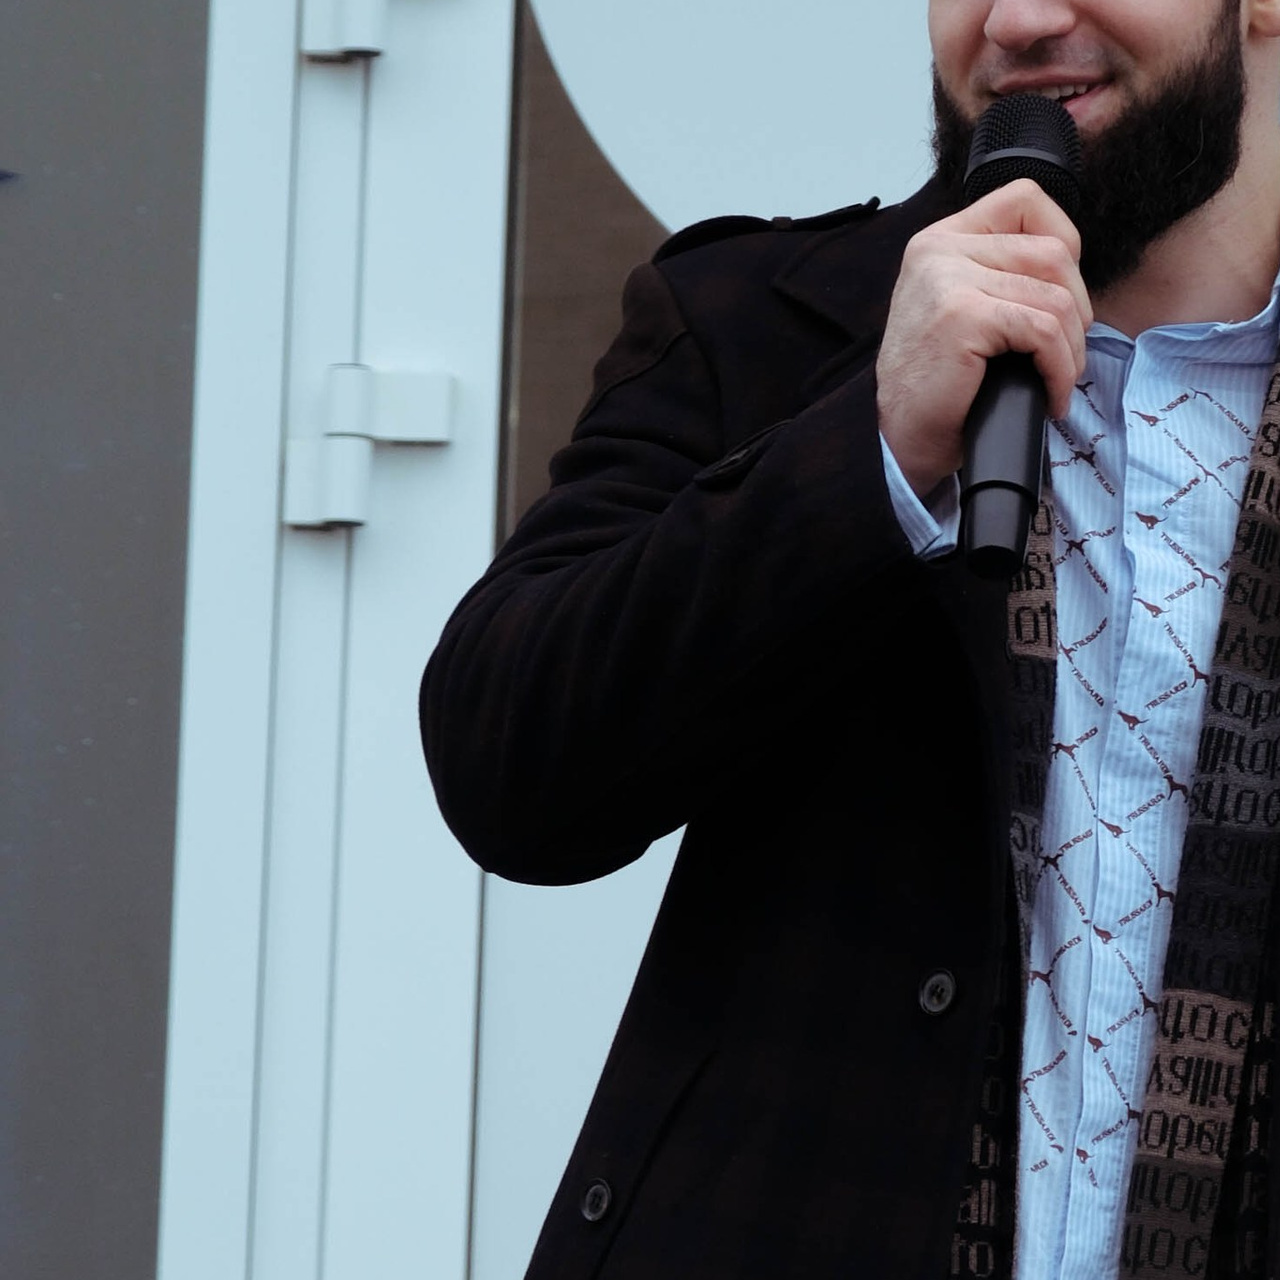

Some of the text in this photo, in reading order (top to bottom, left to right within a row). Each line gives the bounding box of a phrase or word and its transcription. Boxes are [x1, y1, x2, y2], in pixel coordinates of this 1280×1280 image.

[1144, 679, 1189, 712] TRUSSARDI
[1137, 732, 1171, 776] TRUSSARDI
[1126, 792, 1167, 823] TRUSSARDI
[1024, 1097, 1057, 1142] TRUSSARDI
